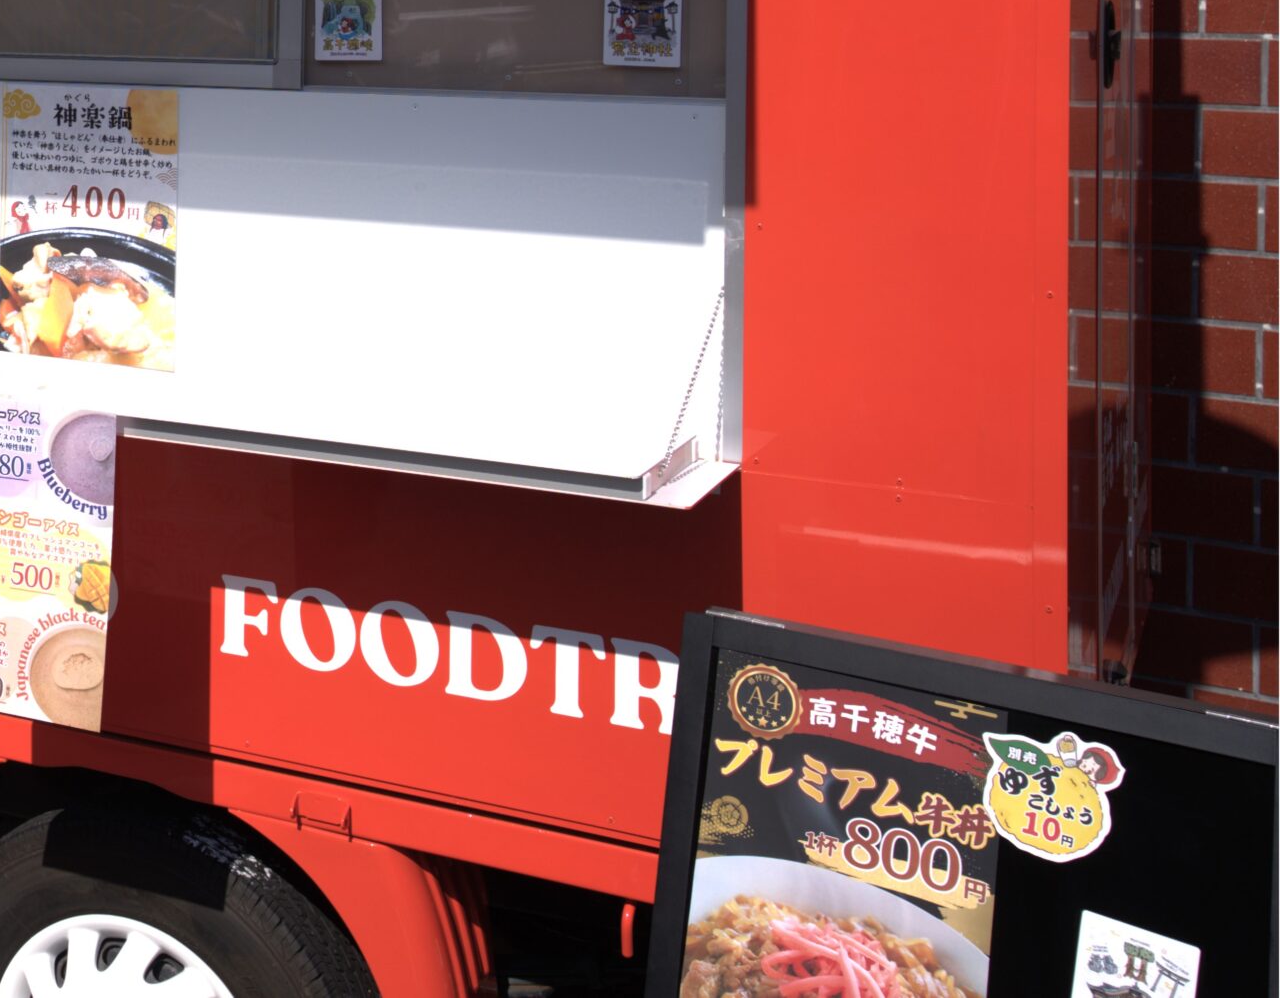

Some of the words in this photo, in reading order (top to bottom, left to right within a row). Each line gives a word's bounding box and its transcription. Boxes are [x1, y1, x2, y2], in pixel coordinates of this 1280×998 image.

[54, 103, 132, 130] 神楽鍋
[37, 458, 108, 520] Blueberry
[16, 627, 40, 701] Japanese
[39, 608, 80, 631] black
[82, 611, 106, 631] tea
[746, 686, 781, 711] A4
[809, 697, 939, 756] 高千穂牛
[1007, 746, 1037, 765] 別売
[715, 738, 996, 850] プレミアム牛丼
[999, 766, 1063, 795] ゆず
